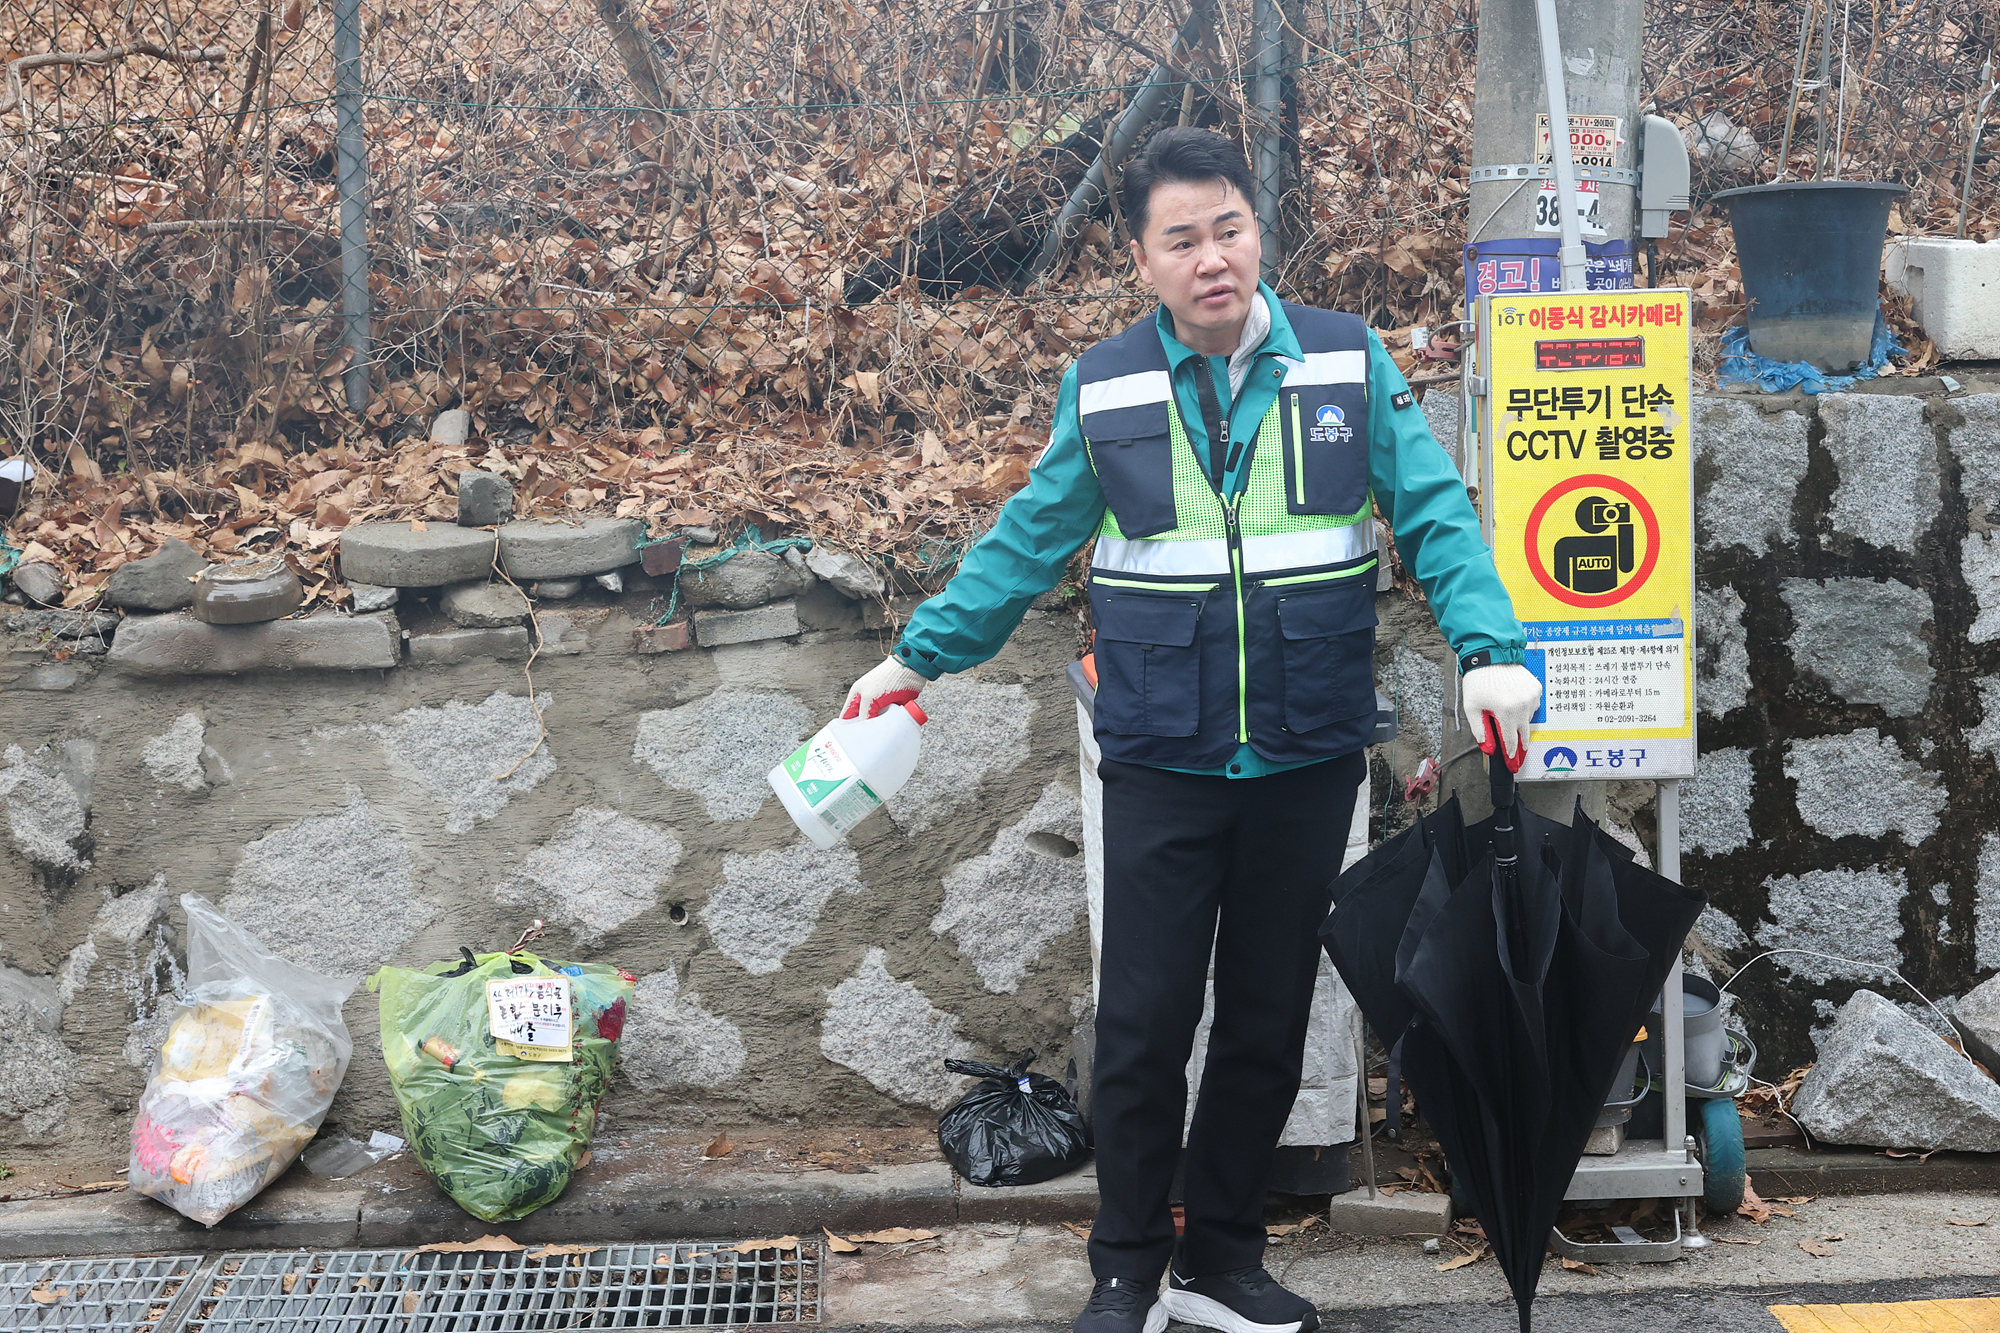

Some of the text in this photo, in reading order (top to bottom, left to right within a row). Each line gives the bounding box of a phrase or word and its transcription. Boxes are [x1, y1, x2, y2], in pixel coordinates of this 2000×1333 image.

[1477, 257, 1540, 294] 경고!
[1529, 306, 1583, 330] 이동식
[1589, 303, 1683, 329] 감시카메라
[1506, 383, 1675, 422] 무단투기 단속
[1309, 427, 1354, 442] 도봉구
[1506, 425, 1675, 461] CCTV 촬영중
[1578, 558, 1610, 569] AUTO
[1573, 625, 1588, 636] 규격
[1590, 624, 1614, 636] 봉투에
[1616, 624, 1633, 635] 담아
[1547, 645, 1595, 657] 개인정보보호법
[1597, 645, 1618, 656] 제25조
[1666, 643, 1679, 654] 의거
[1555, 662, 1586, 673] 설치목적
[1594, 661, 1618, 671] 쓰레기
[1621, 661, 1652, 672] 불법투기
[1655, 660, 1672, 671] 단속
[1554, 675, 1586, 686] 녹화시간
[1594, 675, 1619, 685] 24시간
[1622, 675, 1638, 685] 연중
[1554, 688, 1586, 699] 촬영범위
[1595, 687, 1642, 698] 카메라로부터
[1555, 701, 1586, 712] 관리책임
[1595, 701, 1635, 712] 자원순환과
[1604, 714, 1657, 723] 02-2091-3264
[1585, 748, 1648, 769] 도봉구
[510, 1021, 536, 1042] 배출
